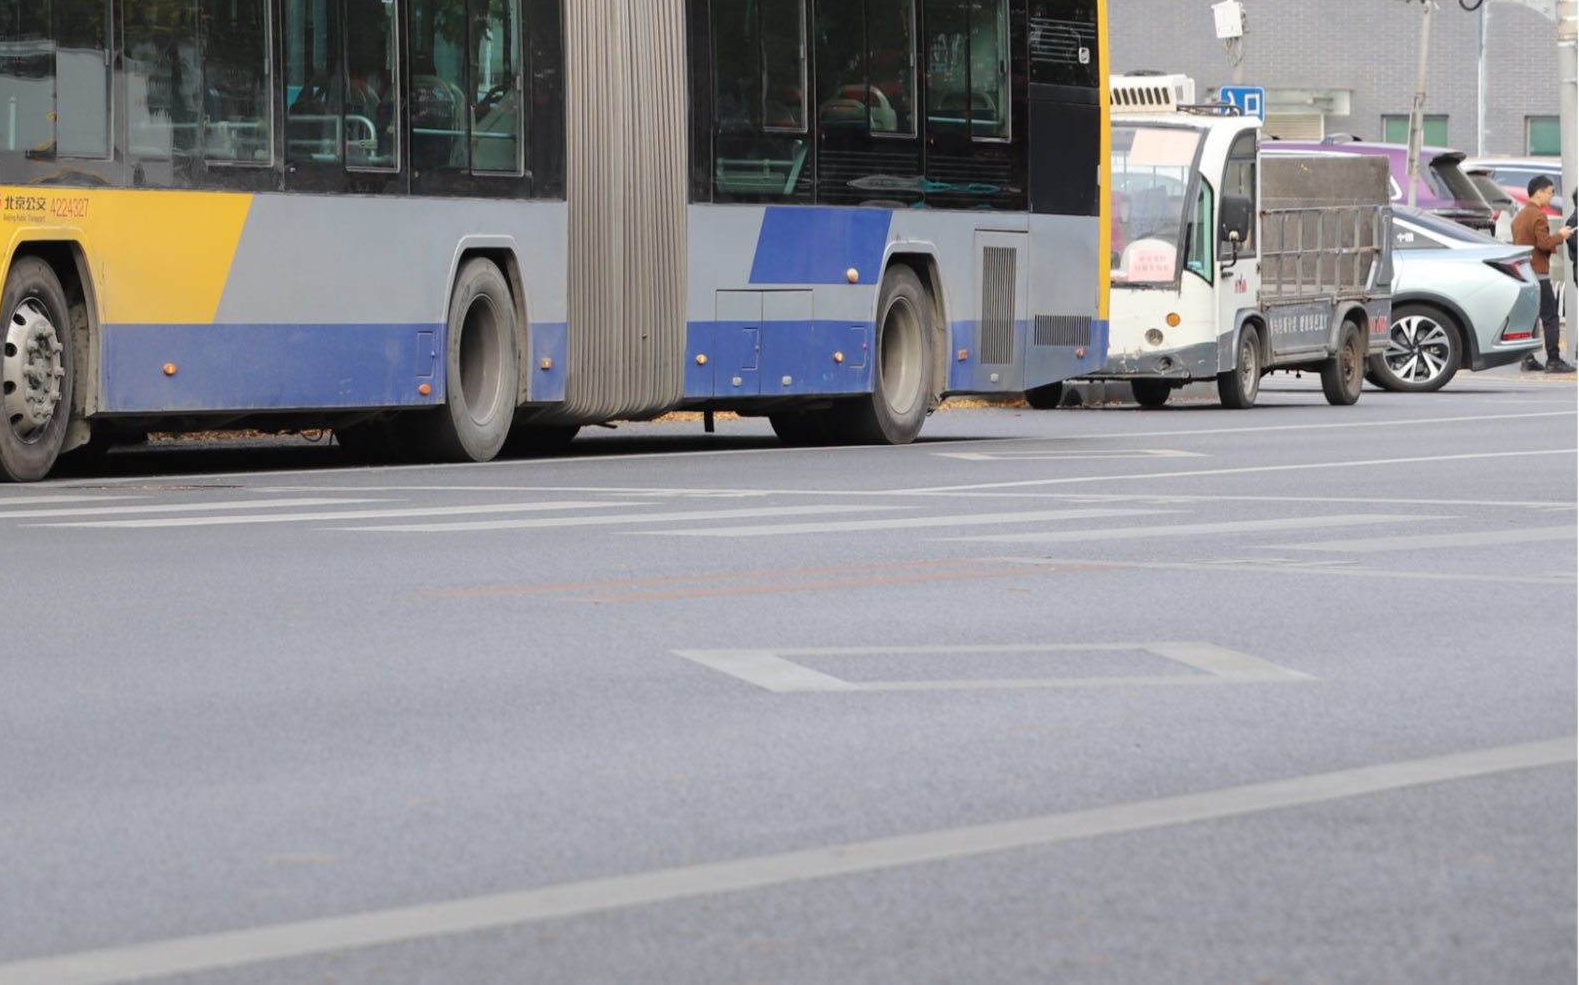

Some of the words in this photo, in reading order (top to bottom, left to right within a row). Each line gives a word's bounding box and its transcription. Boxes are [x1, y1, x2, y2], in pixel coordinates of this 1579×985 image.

[4, 196, 46, 211] 北京公交
[50, 197, 89, 217] 4224327
